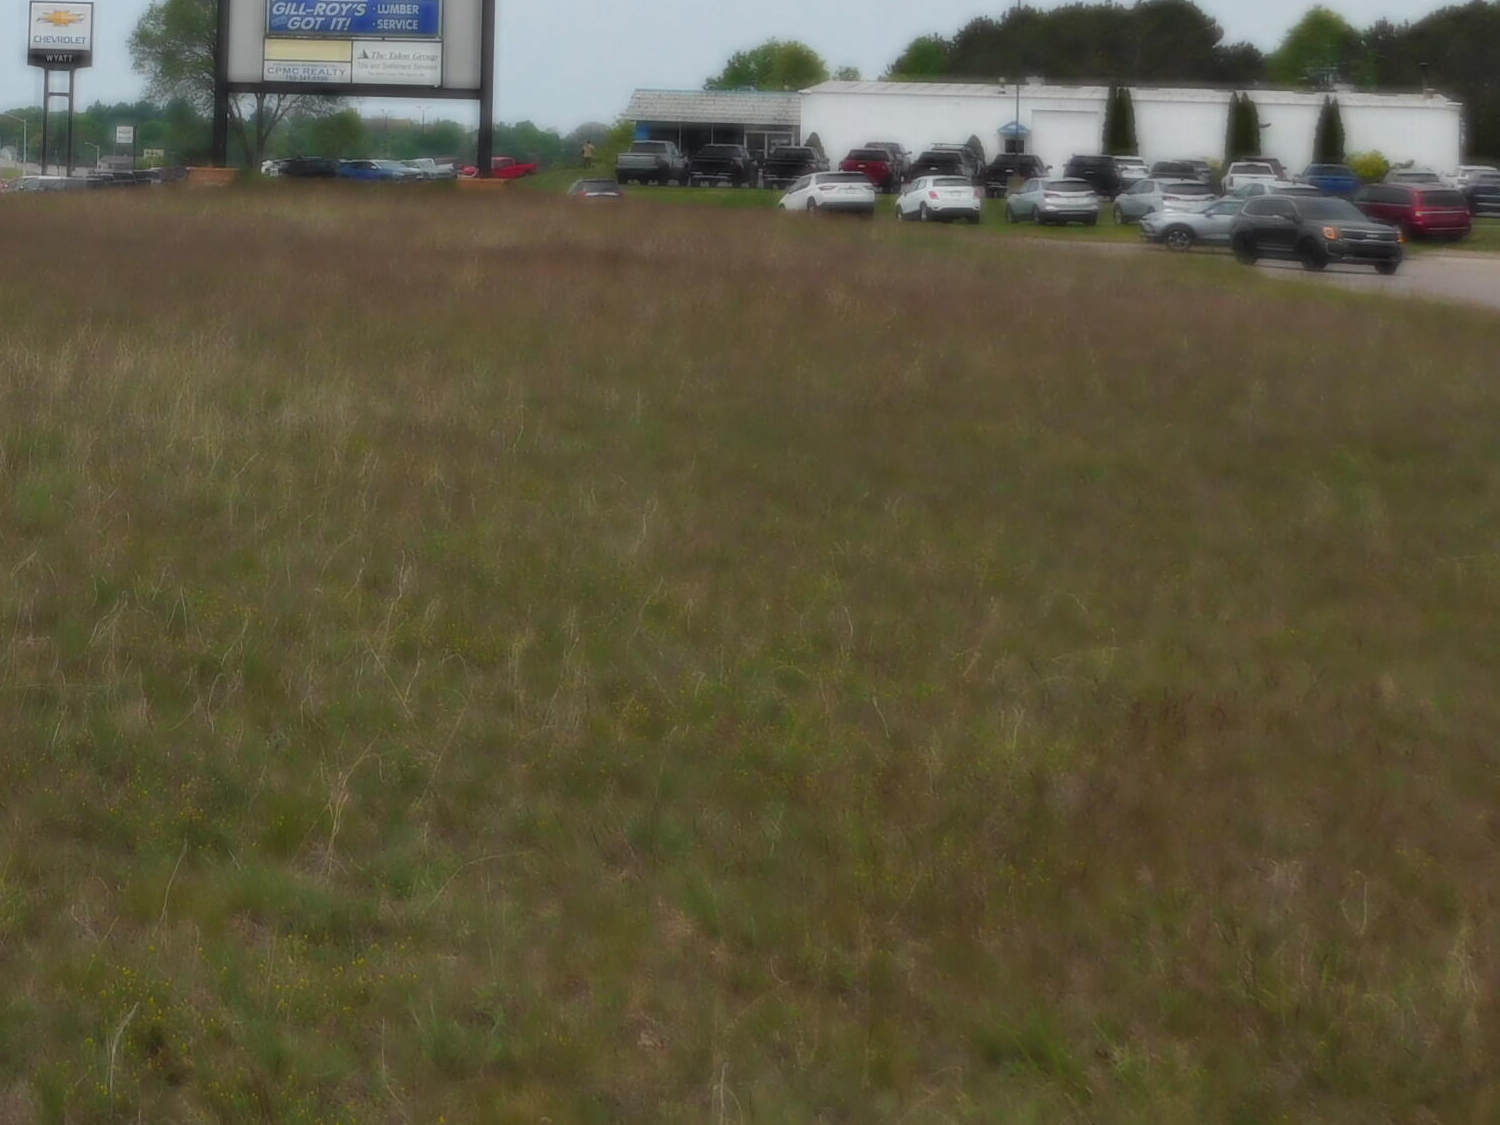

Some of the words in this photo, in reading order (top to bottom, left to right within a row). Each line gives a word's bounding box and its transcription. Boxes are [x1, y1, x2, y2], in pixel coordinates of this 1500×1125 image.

[272, 2, 367, 17] GILL-ROY'S
[377, 4, 419, 15] LUMBER
[287, 16, 325, 30] GOT
[330, 17, 352, 31] IT!
[377, 19, 419, 30] SERVICE
[33, 35, 86, 44] CHEVROLET
[46, 54, 73, 63] WYATT
[267, 67, 299, 75] CPMC
[303, 67, 346, 76] REALTY
